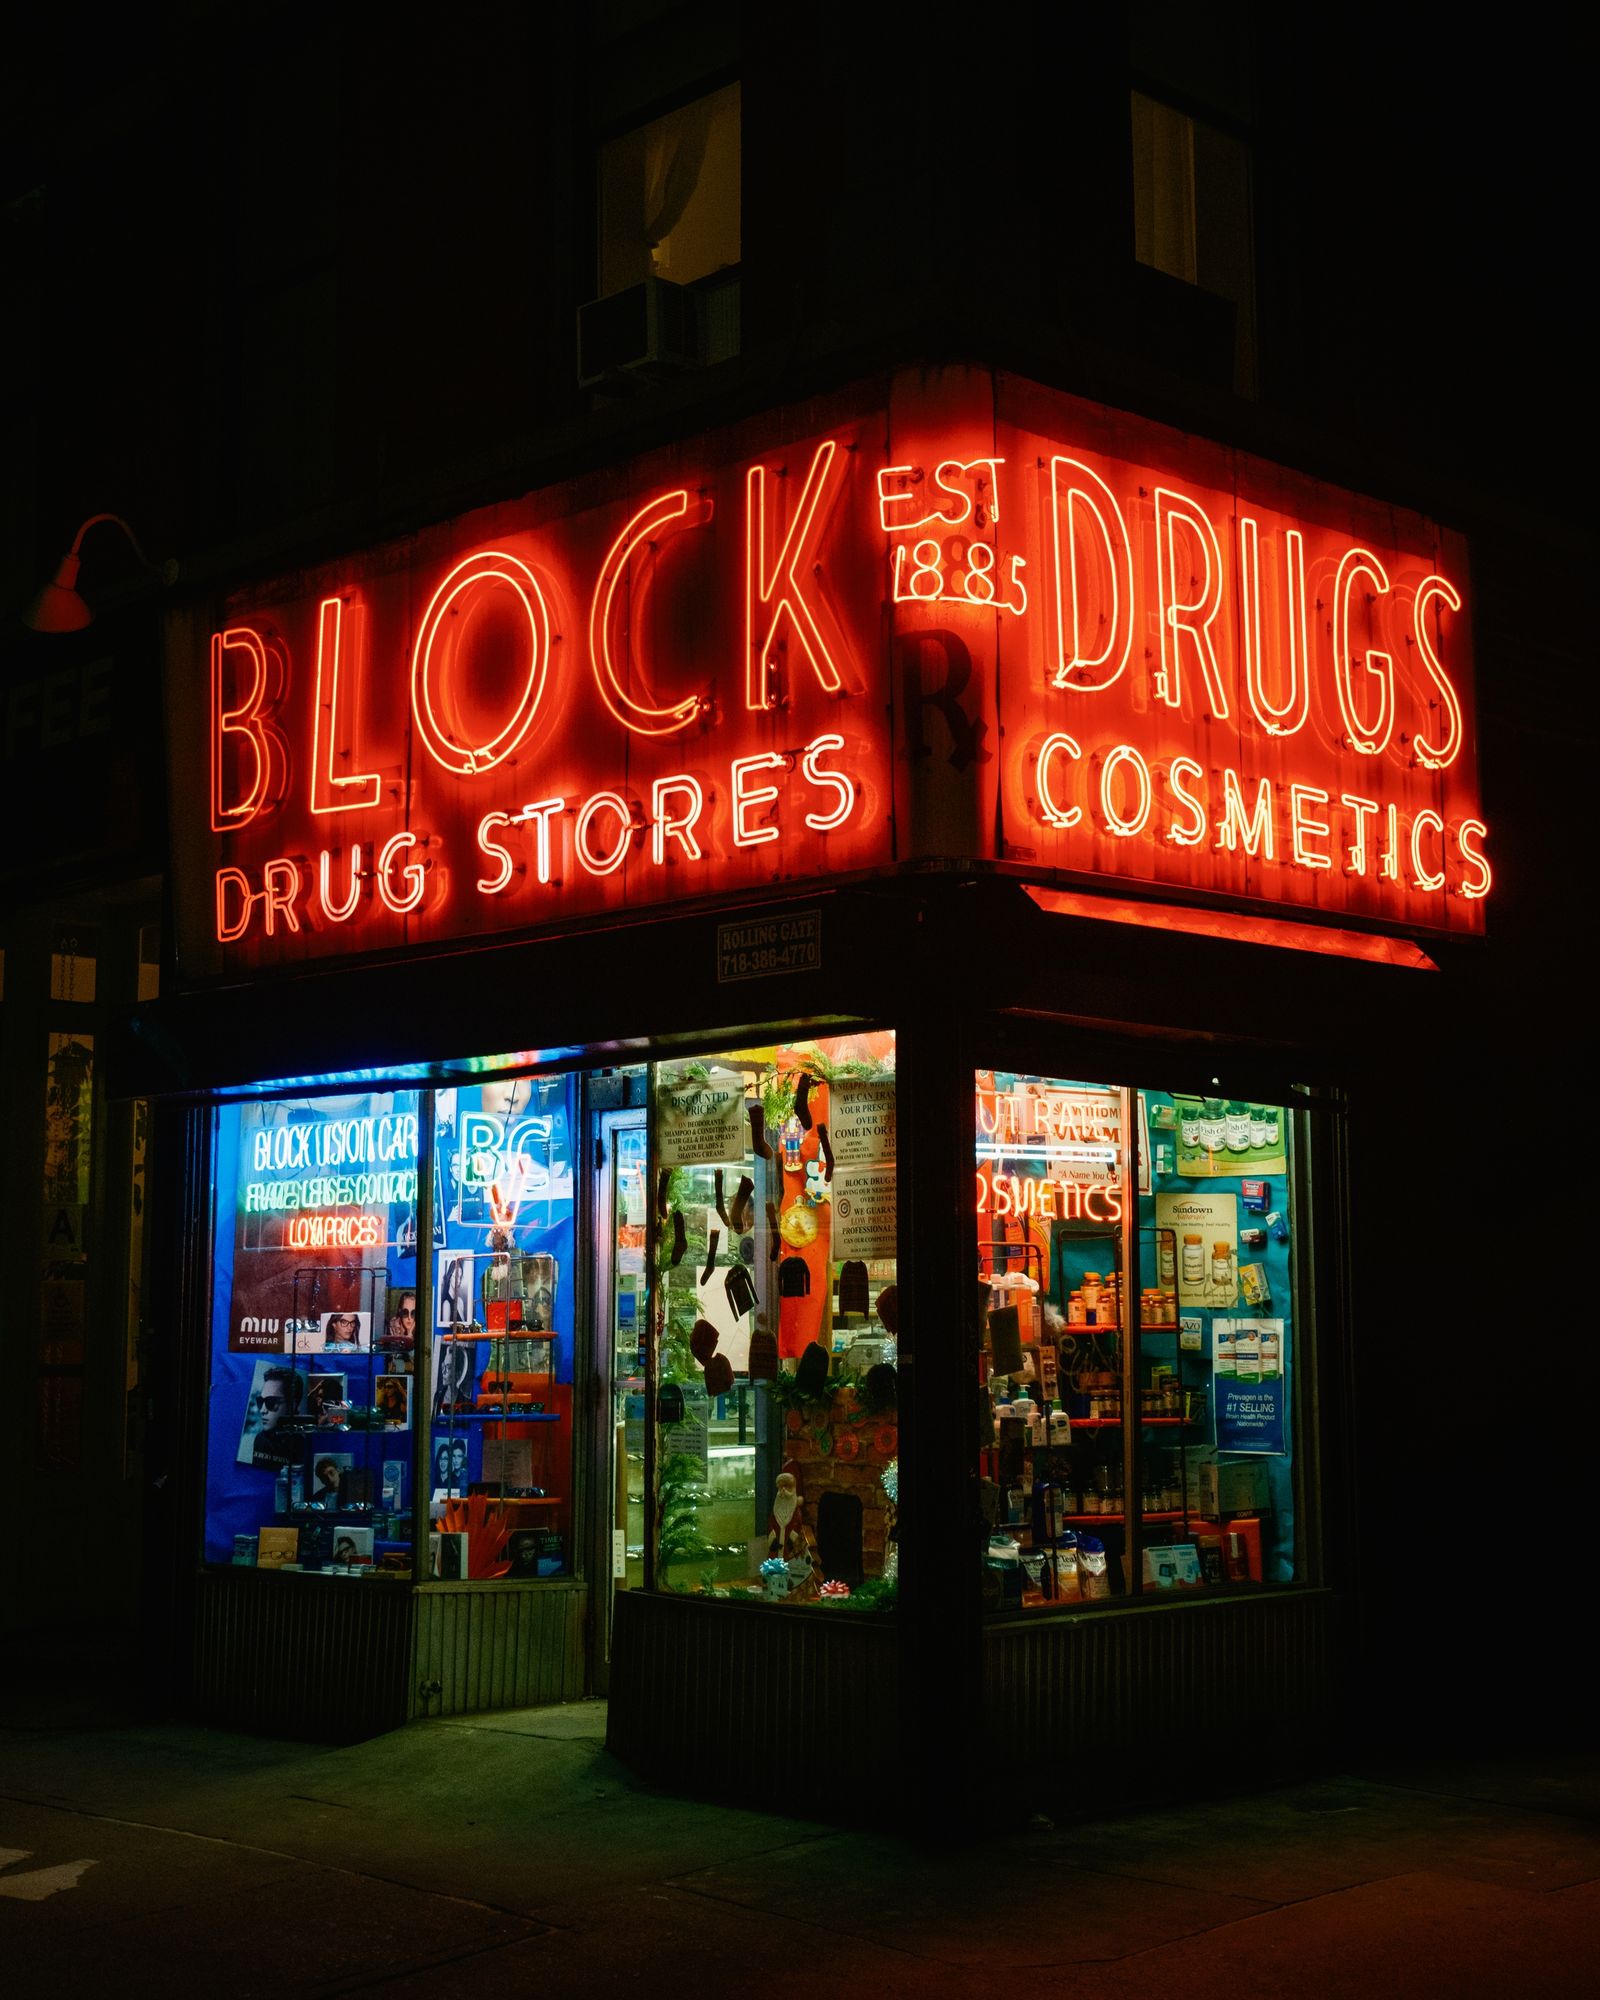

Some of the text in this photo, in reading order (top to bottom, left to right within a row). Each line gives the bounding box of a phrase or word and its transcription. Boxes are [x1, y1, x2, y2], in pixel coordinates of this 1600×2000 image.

[877, 458, 1006, 532] EST
[893, 539, 1028, 615] 1885
[1051, 455, 1462, 769] DRUGS
[210, 440, 841, 833] BLOCK
[1036, 732, 1492, 900] COSMETICS
[215, 733, 855, 943] DRUG STORES
[722, 919, 816, 951] ROLLING GATE
[722, 941, 816, 976] 718-386-4770
[672, 1092, 729, 1108] DISCOUNTED
[843, 1094, 855, 1102] WE
[857, 1092, 873, 1101] CAN
[686, 1104, 717, 1116] PRICES
[840, 1105, 861, 1115] YOUR
[687, 1119, 724, 1128] DEODORANTS
[856, 1115, 878, 1125] OVER
[1034, 1098, 1110, 1142] RATE
[664, 1129, 691, 1137] SHAMPOO
[697, 1125, 739, 1135] CONDITIONERS
[835, 1127, 861, 1139] COME
[862, 1127, 872, 1136] IN
[873, 1125, 887, 1135] OR
[715, 1133, 735, 1141] SPRAYS
[254, 1124, 313, 1172] BLOCK
[678, 1144, 697, 1152] RAZOR
[677, 1151, 701, 1159] SHAVING
[1069, 1171, 1090, 1180] Name
[1092, 1171, 1105, 1180] You
[845, 1178, 868, 1187] BLOCK
[870, 1176, 891, 1185] DRUG
[301, 1176, 355, 1209] LENSES
[854, 1207, 865, 1215] WE
[1172, 1205, 1213, 1214] Sundown
[323, 1215, 379, 1247] PRICES
[842, 1225, 892, 1235] PROFESSIONAL
[1183, 1321, 1200, 1330] AZO
[239, 1336, 279, 1345] EYEWEAR
[297, 1336, 310, 1349] ck
[1227, 1393, 1273, 1402] Prevagen is the
[1226, 1402, 1275, 1413] #1 SELLING
[539, 1535, 564, 1545] TIMEX
